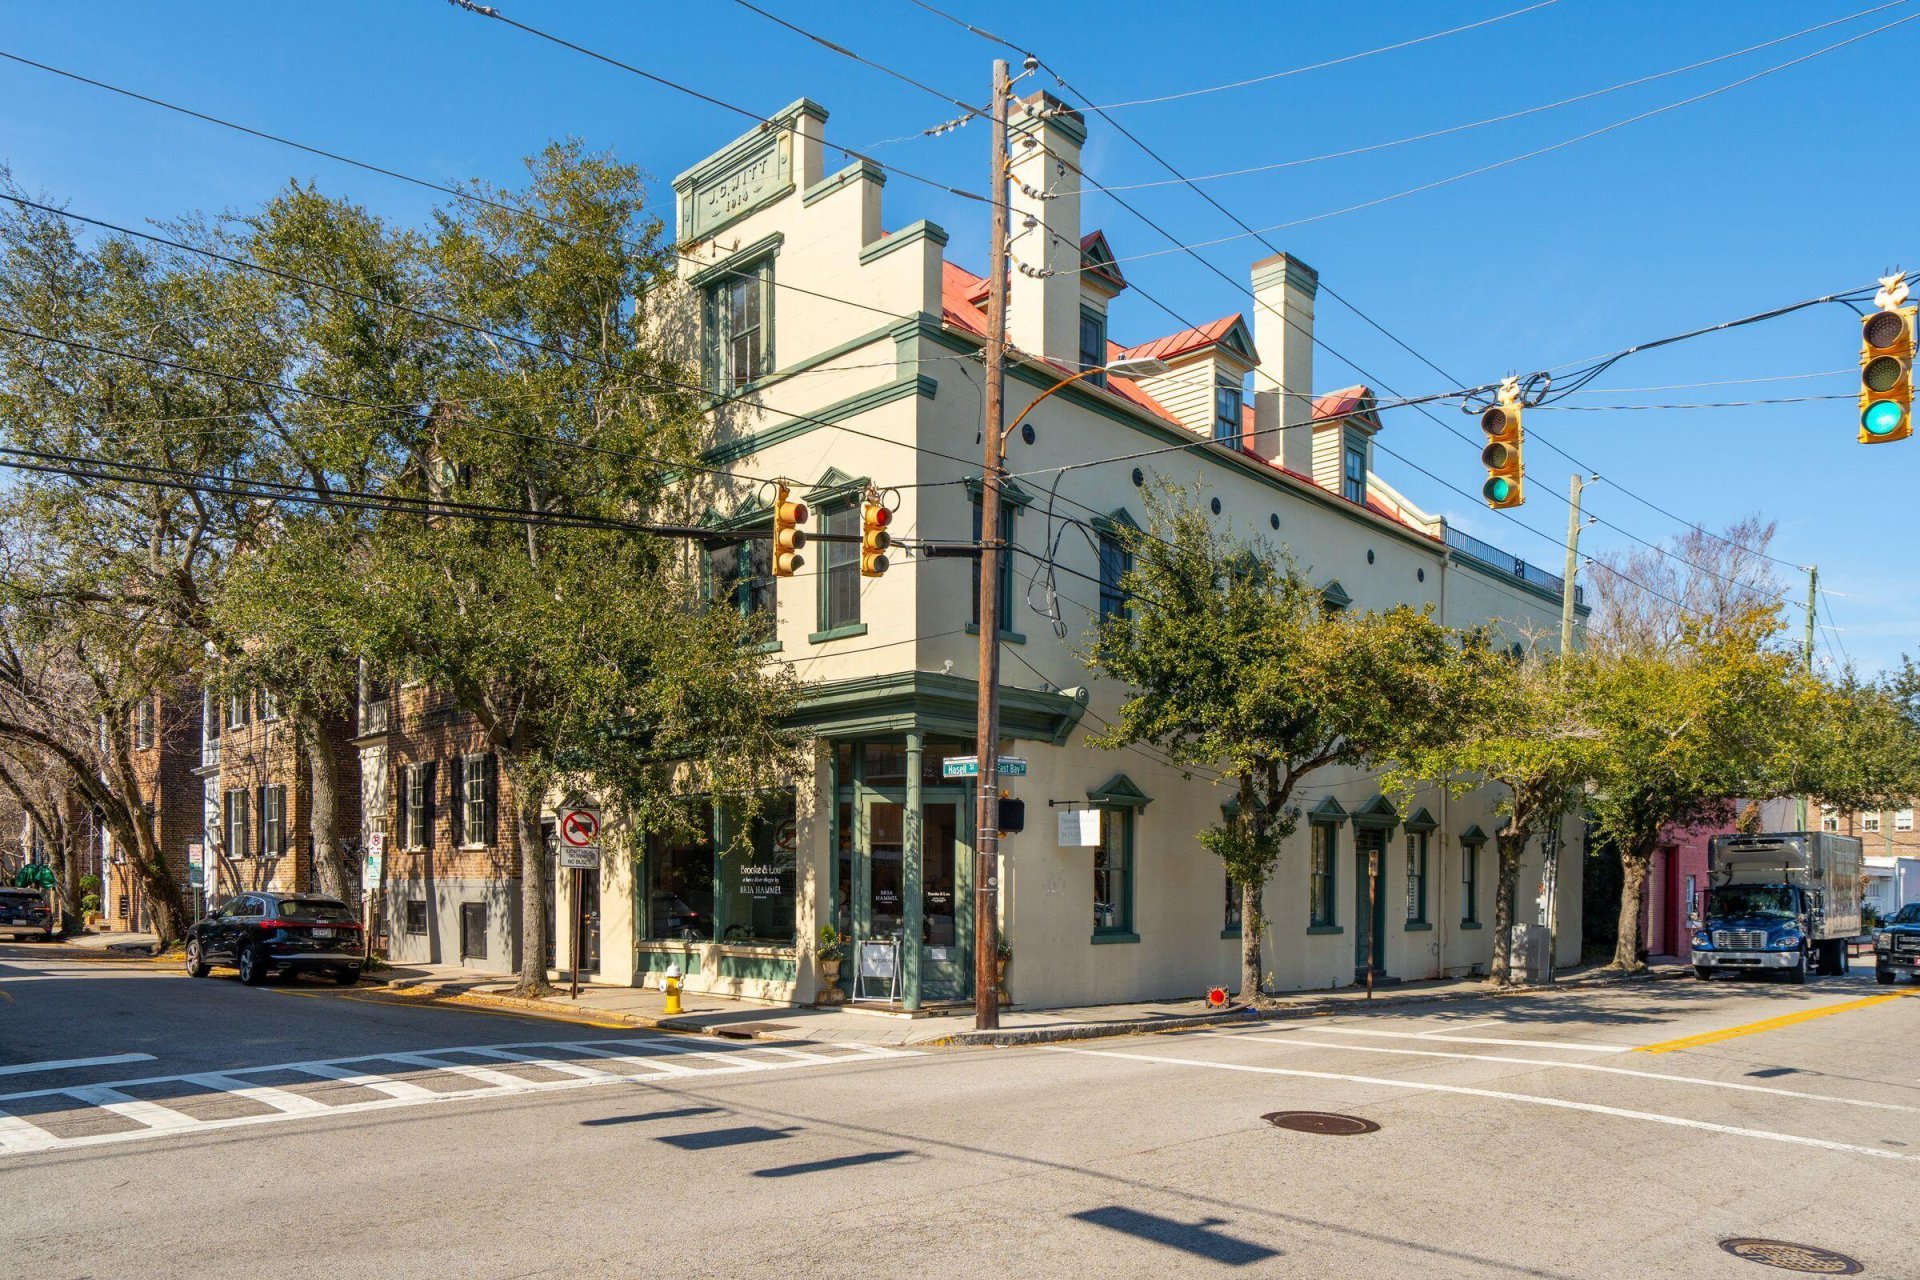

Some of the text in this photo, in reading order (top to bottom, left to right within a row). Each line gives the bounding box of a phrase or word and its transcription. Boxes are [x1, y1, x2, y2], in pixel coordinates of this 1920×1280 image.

[732, 159, 767, 192] WITT
[948, 764, 966, 774] Hasell
[1010, 764, 1020, 774] Bay
[740, 864, 782, 875] Brooke & Lou
[740, 885, 782, 894] BRIA HAMMEL
